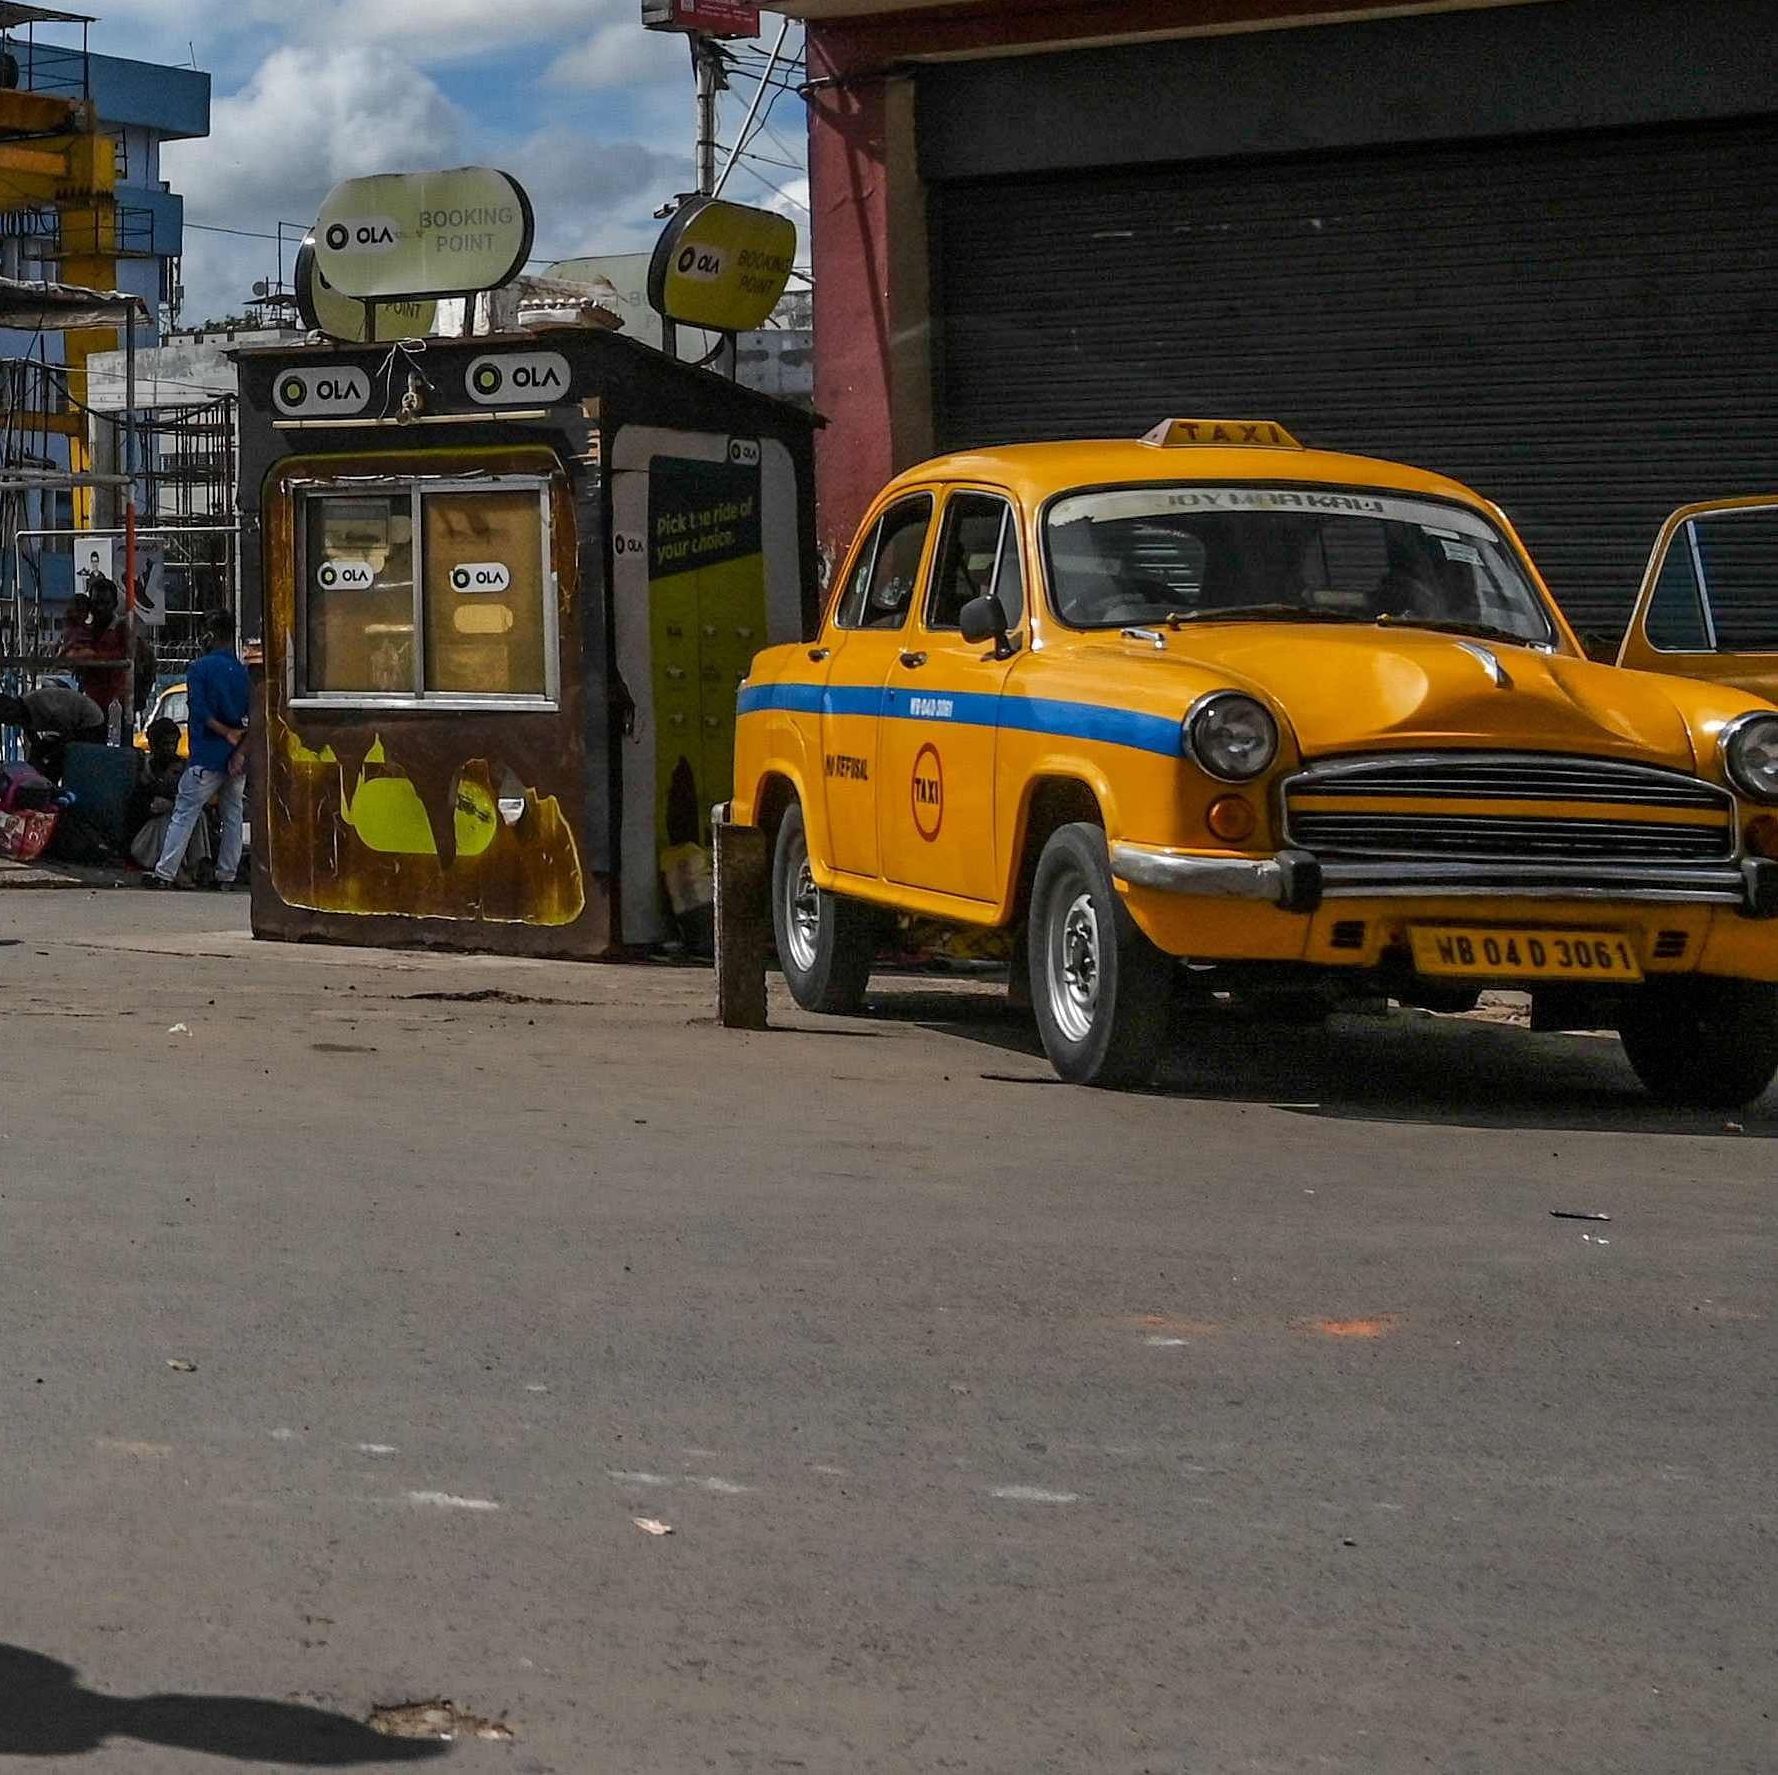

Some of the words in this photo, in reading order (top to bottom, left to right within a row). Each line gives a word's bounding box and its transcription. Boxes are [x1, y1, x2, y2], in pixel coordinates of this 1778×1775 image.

[420, 207, 513, 228] BOOKING
[356, 226, 393, 245] OLA
[436, 233, 495, 252] POINT
[697, 255, 719, 274] OLA
[737, 249, 792, 274] BOOKING
[739, 275, 775, 294] POINT
[512, 367, 561, 388] OLA
[316, 380, 361, 400] OLA
[1179, 422, 1280, 444] TAXI
[657, 512, 688, 536] Pick
[715, 503, 740, 523] ride
[657, 539, 691, 566] your
[343, 569, 368, 582] OLA
[476, 571, 504, 584] OLA
[914, 777, 939, 805] TAXI
[1436, 935, 1475, 965] WB
[1554, 939, 1631, 970] 3061
